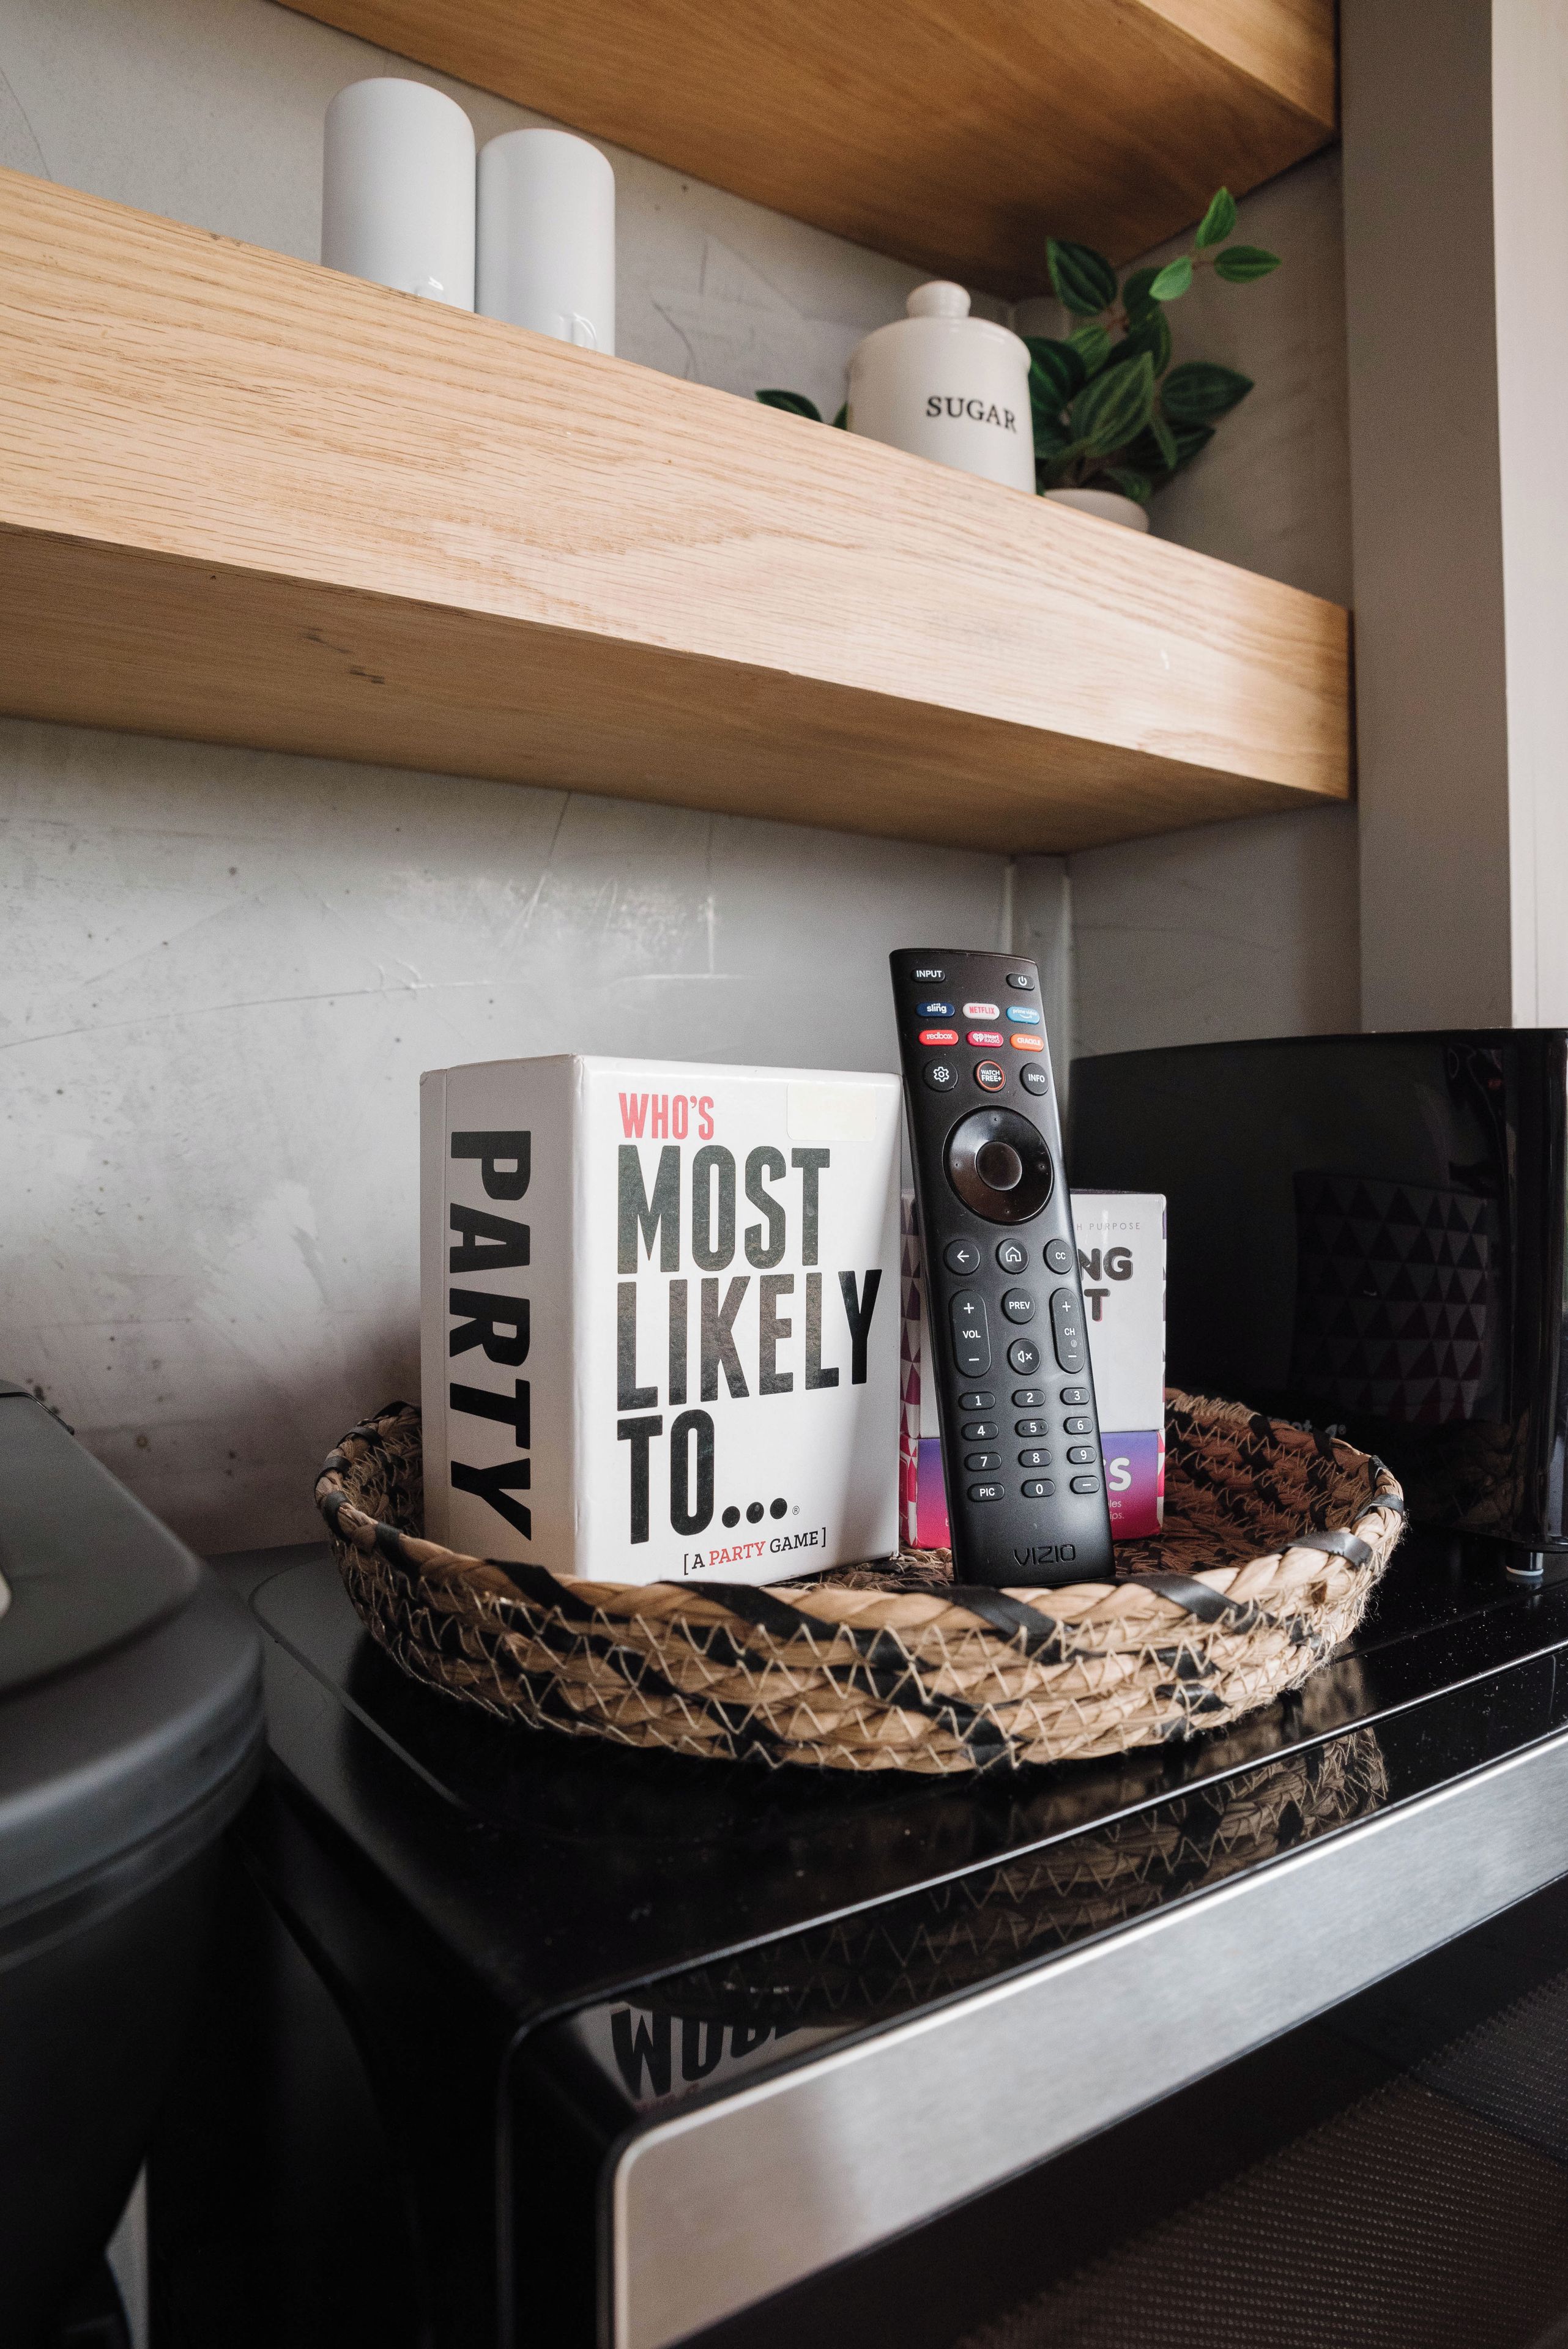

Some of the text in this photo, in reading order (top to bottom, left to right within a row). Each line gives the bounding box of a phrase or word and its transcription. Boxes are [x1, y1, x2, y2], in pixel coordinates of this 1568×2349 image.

[926, 395, 1017, 433] SUGAR
[916, 970, 942, 978] INPUT
[926, 1003, 947, 1014] sling
[969, 1006, 995, 1015] NETFLIX
[1017, 1037, 1041, 1046] CRACKLE
[1028, 1074, 1045, 1083] INFO
[619, 1093, 715, 1140] WHO'S
[617, 1145, 830, 1274] MOST
[1089, 1222, 1141, 1231] PURPOSE
[1055, 1252, 1066, 1260] CC
[1009, 1301, 1030, 1310] PREV
[449, 1130, 532, 1542] PARTY
[962, 1330, 981, 1338] VOL
[1065, 1327, 1076, 1336] CH
[617, 1269, 882, 1411] LIKELY
[975, 1390, 1080, 1406] 1 2 3
[977, 1420, 1084, 1436] 4 5 6
[980, 1450, 1087, 1467] 7 8 9
[979, 1484, 1044, 1497] PIC 0
[709, 1541, 766, 1566] PARTY
[1013, 1543, 1077, 1567] VIZIO
